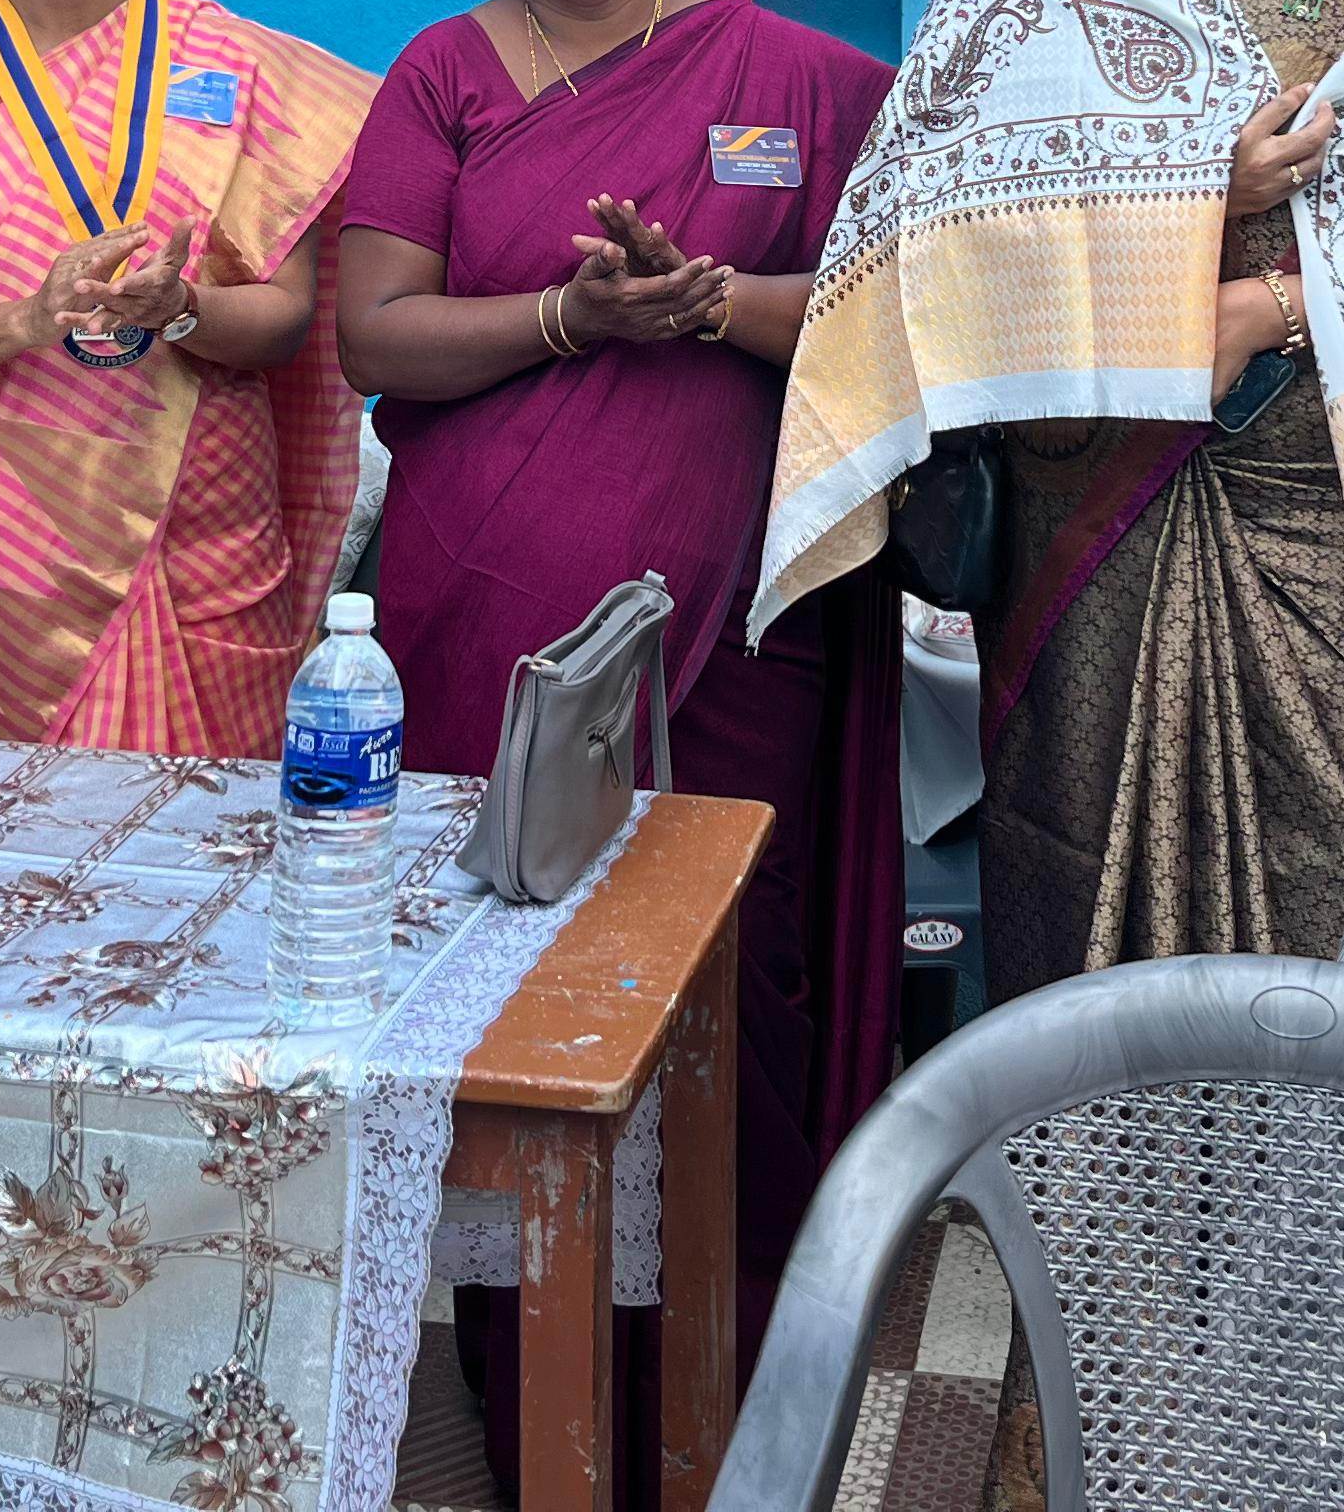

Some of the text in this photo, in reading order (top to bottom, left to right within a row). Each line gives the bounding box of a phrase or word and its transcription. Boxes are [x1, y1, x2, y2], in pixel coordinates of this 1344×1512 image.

[77, 350, 139, 366] PRESIDENT
[359, 729, 393, 760] Auro
[369, 746, 400, 782] RE
[910, 933, 954, 944] GALAXY
